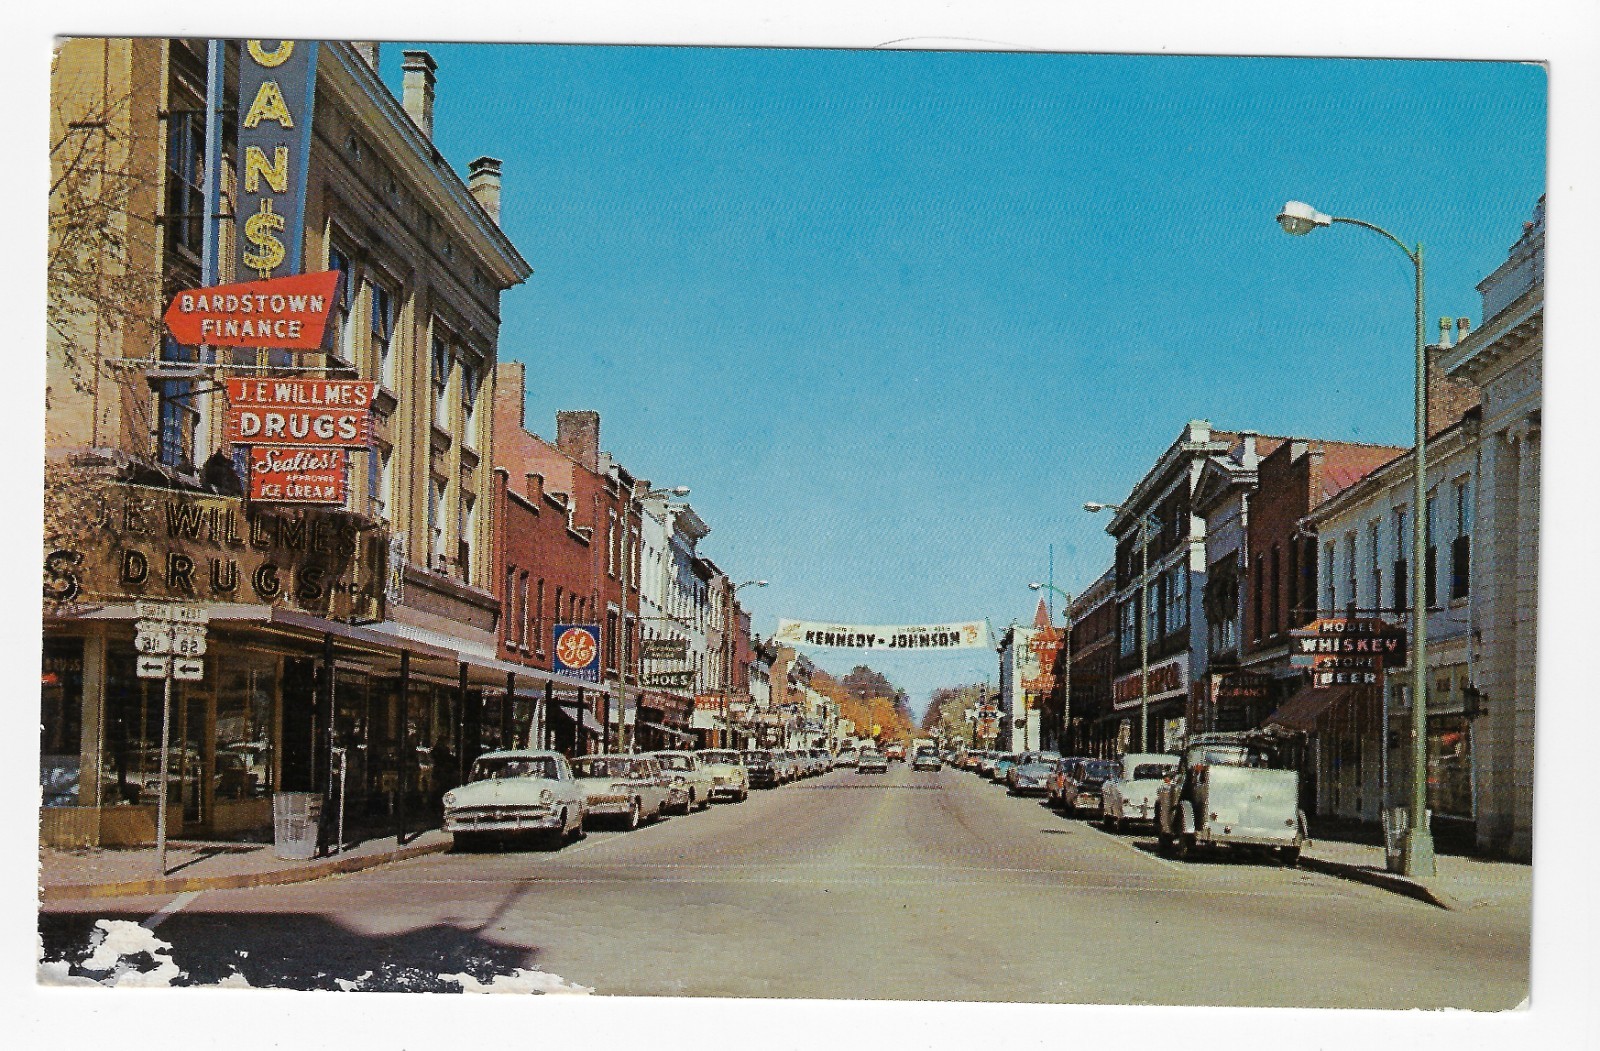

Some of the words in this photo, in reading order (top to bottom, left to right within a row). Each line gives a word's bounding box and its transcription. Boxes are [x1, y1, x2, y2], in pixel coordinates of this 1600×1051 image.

[180, 293, 324, 314] BARDSTOWN
[201, 319, 302, 340] FINANCE
[240, 412, 358, 440] DRUGS
[252, 449, 339, 474] Sealtest
[261, 484, 281, 497] ICE
[286, 484, 335, 498] CREAM
[165, 502, 357, 558] WILLMES
[120, 549, 324, 601] DRUGS
[180, 640, 198, 653] 62
[805, 629, 875, 647] KENNEDY
[889, 631, 961, 648] JOHNSON
[1297, 638, 1398, 652] WHISKEY
[642, 674, 689, 686] SHOES
[1320, 672, 1377, 685] BEER
